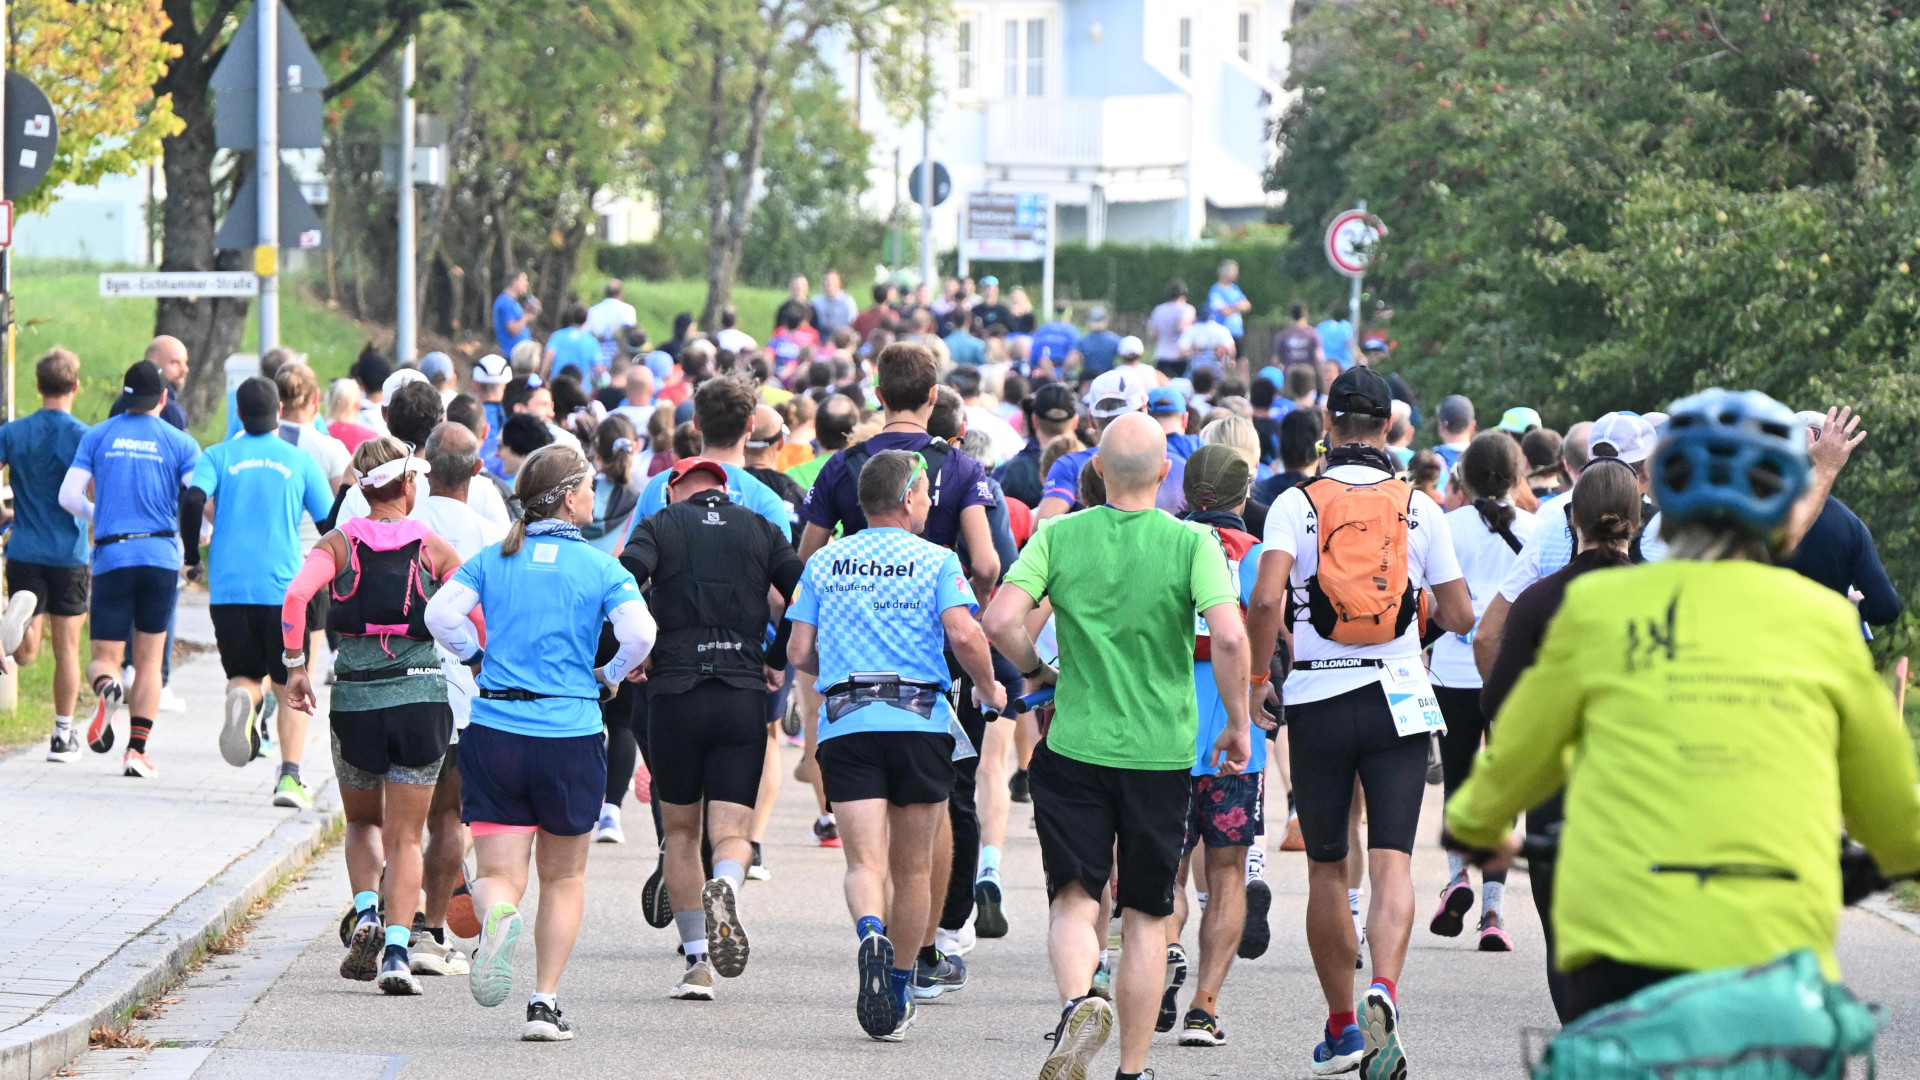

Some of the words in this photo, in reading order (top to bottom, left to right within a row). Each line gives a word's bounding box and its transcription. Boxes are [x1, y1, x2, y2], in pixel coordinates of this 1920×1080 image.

[1380, 535, 1391, 571] deuter
[832, 559, 914, 577] Michael
[835, 582, 875, 592] laufend
[873, 601, 890, 610] gut
[892, 600, 921, 609] drauf
[1311, 659, 1362, 669] SALOMON
[407, 667, 443, 676] SALOMO
